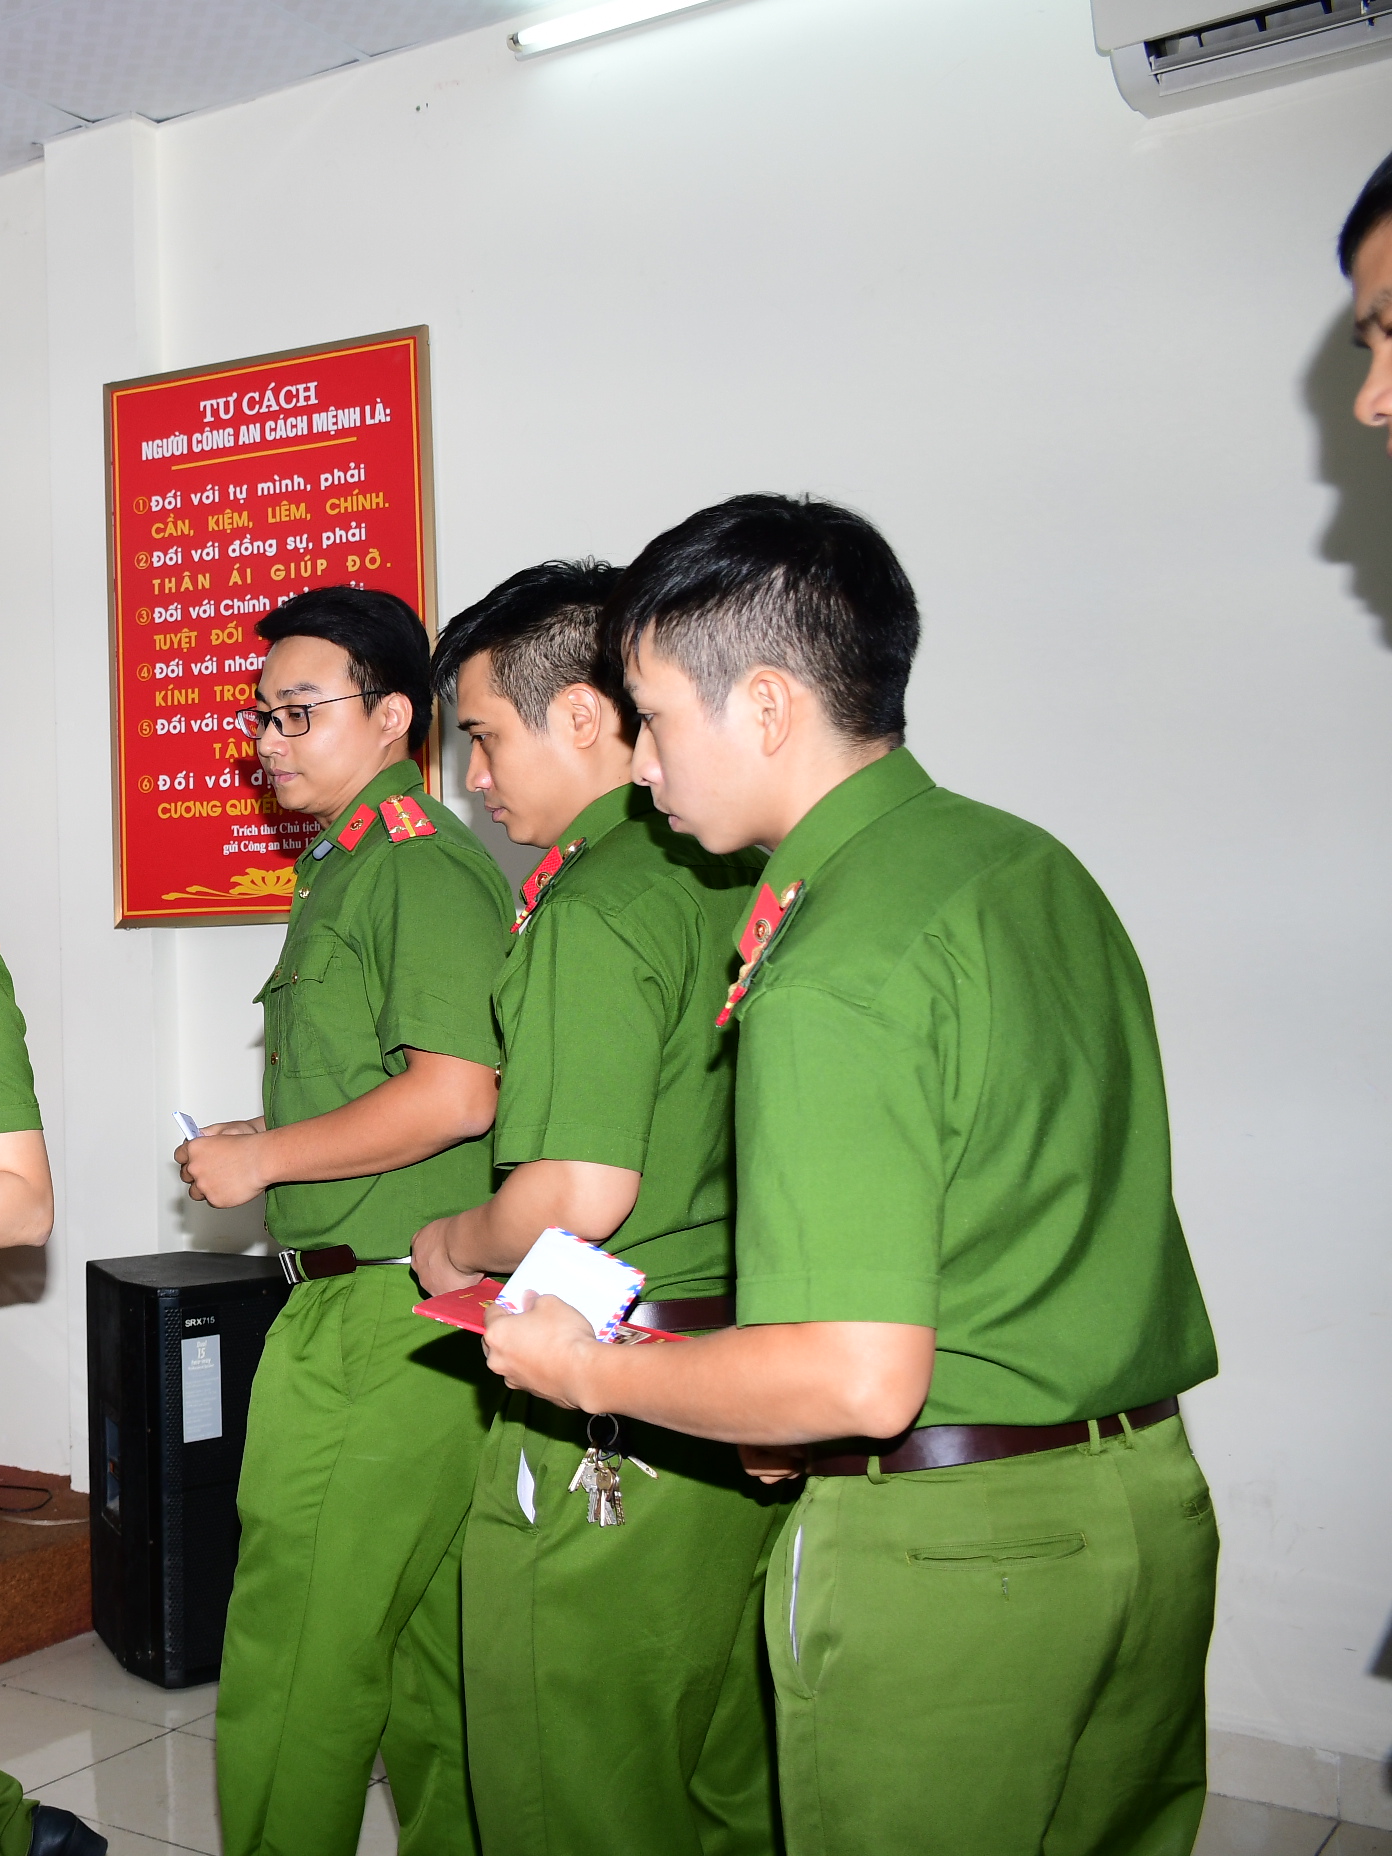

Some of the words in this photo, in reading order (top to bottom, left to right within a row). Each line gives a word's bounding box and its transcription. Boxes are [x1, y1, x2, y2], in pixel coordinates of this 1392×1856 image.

[200, 392, 237, 422] TƯ
[242, 382, 318, 415] CÁCH
[142, 432, 187, 460] NGƯỜI
[192, 427, 234, 452] CÔNG
[239, 423, 260, 445] AN
[265, 414, 308, 440] CÁCH
[312, 406, 360, 435] MỆNH
[365, 398, 390, 425] LÀ:
[150, 490, 181, 511] Đối
[191, 484, 219, 505] với
[228, 484, 247, 503] tự
[258, 475, 311, 496] mình,
[320, 462, 365, 490] phải
[152, 514, 194, 538] CẦN,
[209, 509, 253, 533] KIỆM,
[268, 501, 310, 523] LIÊM,
[326, 489, 389, 514] CHÍNH.
[152, 546, 182, 567] Đối
[191, 541, 219, 562] với
[228, 534, 276, 557] đồng
[286, 534, 313, 553] sự,
[322, 521, 365, 549] phải
[153, 572, 209, 594] THÂN
[229, 563, 251, 586] ÁI
[271, 555, 327, 580] GIÚP
[153, 602, 181, 623] Đối
[189, 599, 214, 619] với
[220, 593, 270, 616] Chính
[154, 628, 197, 652] TUYỆT
[211, 621, 242, 645] ĐỐI
[154, 659, 182, 678] Đối
[191, 655, 217, 675] với
[156, 684, 198, 706] KÍNH
[156, 714, 185, 734] Đối
[190, 713, 217, 732] với
[158, 771, 193, 790] Đối
[205, 768, 239, 788] với
[158, 801, 222, 818] CƯƠNG
[231, 825, 258, 836] Trích
[260, 824, 277, 835] thư
[280, 821, 299, 833] Chủ
[303, 821, 321, 832] tịch
[240, 841, 266, 853] Công
[268, 842, 280, 850] an
[283, 839, 301, 849] khu
[185, 1317, 215, 1327] SRX715
